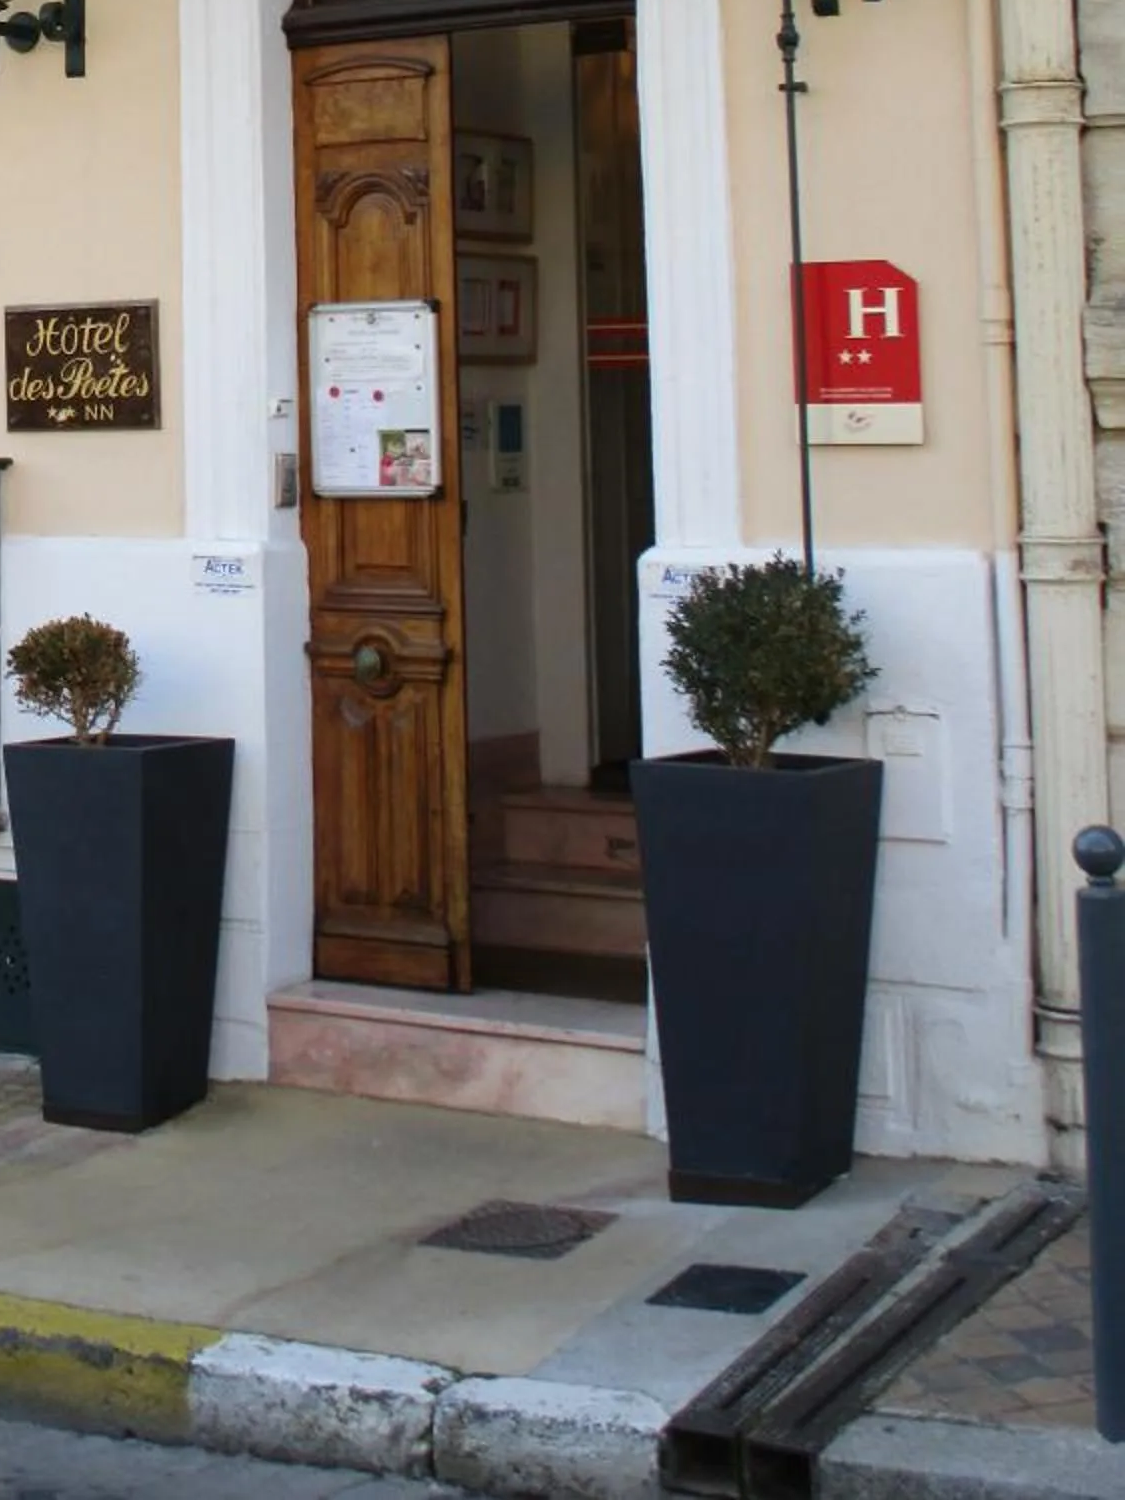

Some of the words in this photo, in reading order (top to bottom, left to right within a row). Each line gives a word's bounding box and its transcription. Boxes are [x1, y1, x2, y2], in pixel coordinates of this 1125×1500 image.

[844, 288, 905, 339] H
[10, 367, 54, 400] des
[84, 404, 114, 420] NN
